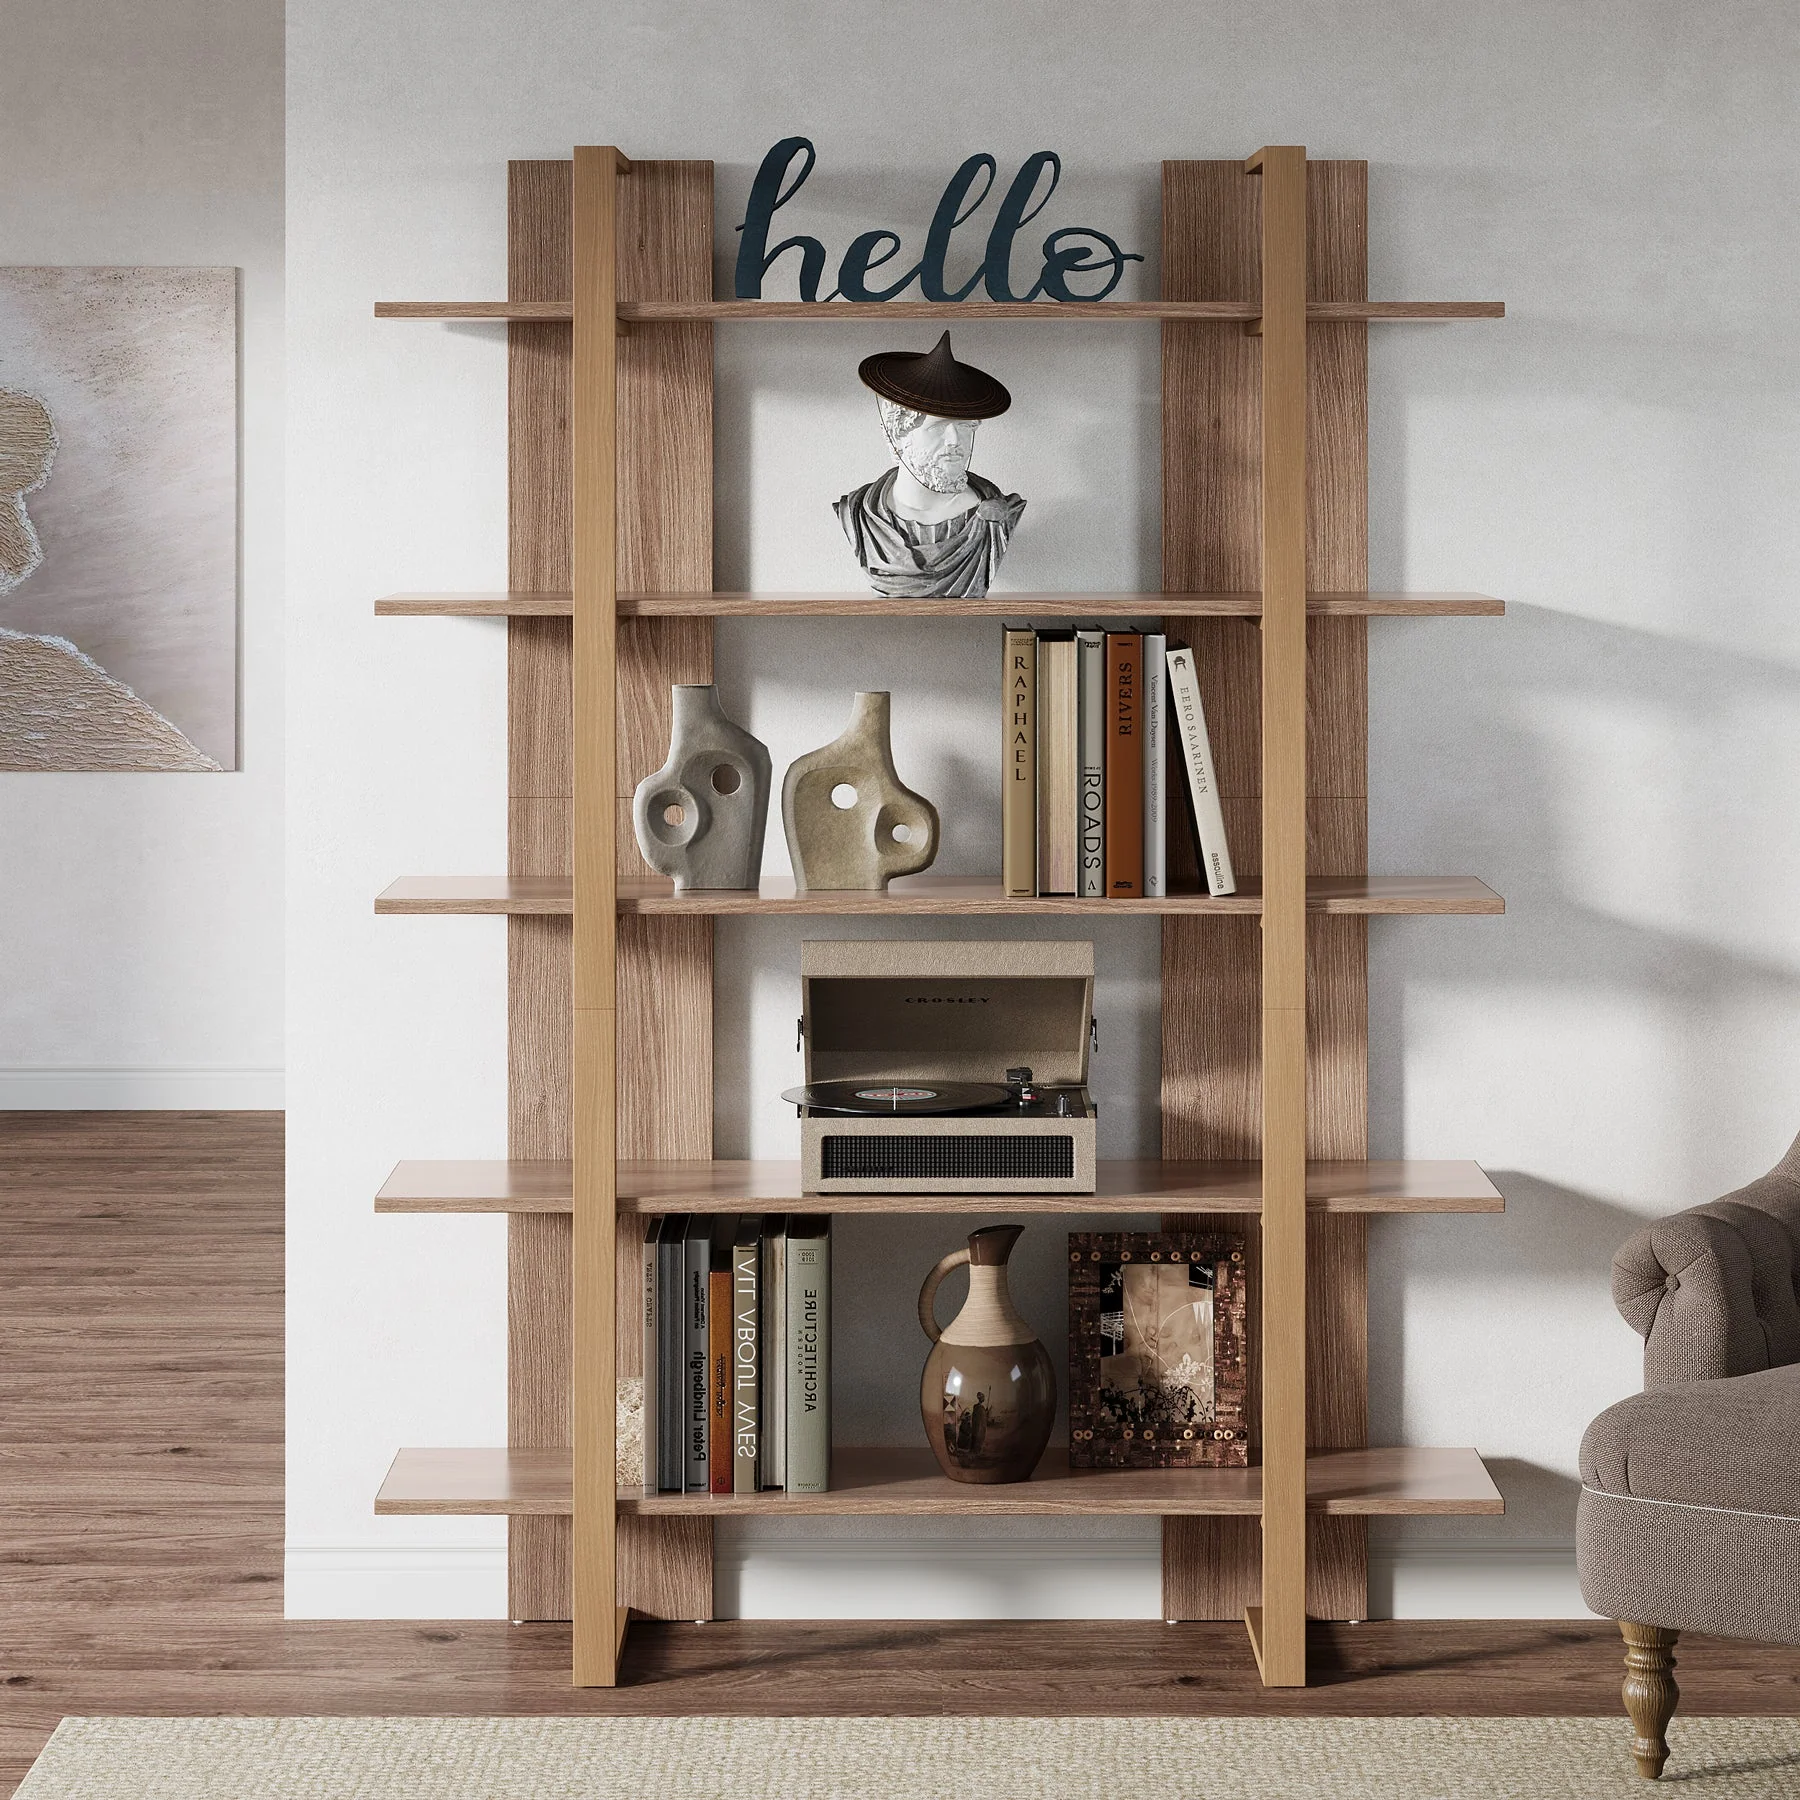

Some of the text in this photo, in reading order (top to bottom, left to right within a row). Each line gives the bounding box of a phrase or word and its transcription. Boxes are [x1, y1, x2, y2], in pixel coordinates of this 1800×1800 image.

[735, 136, 1144, 303] hello
[1014, 656, 1028, 781] RAPHAEL
[1119, 662, 1132, 736] RIVERS
[1150, 674, 1158, 748] Vincent Van Duysen
[1180, 687, 1208, 794] EERO SAARINEN
[1083, 773, 1101, 869] ROADS
[1211, 852, 1224, 890] assouline
